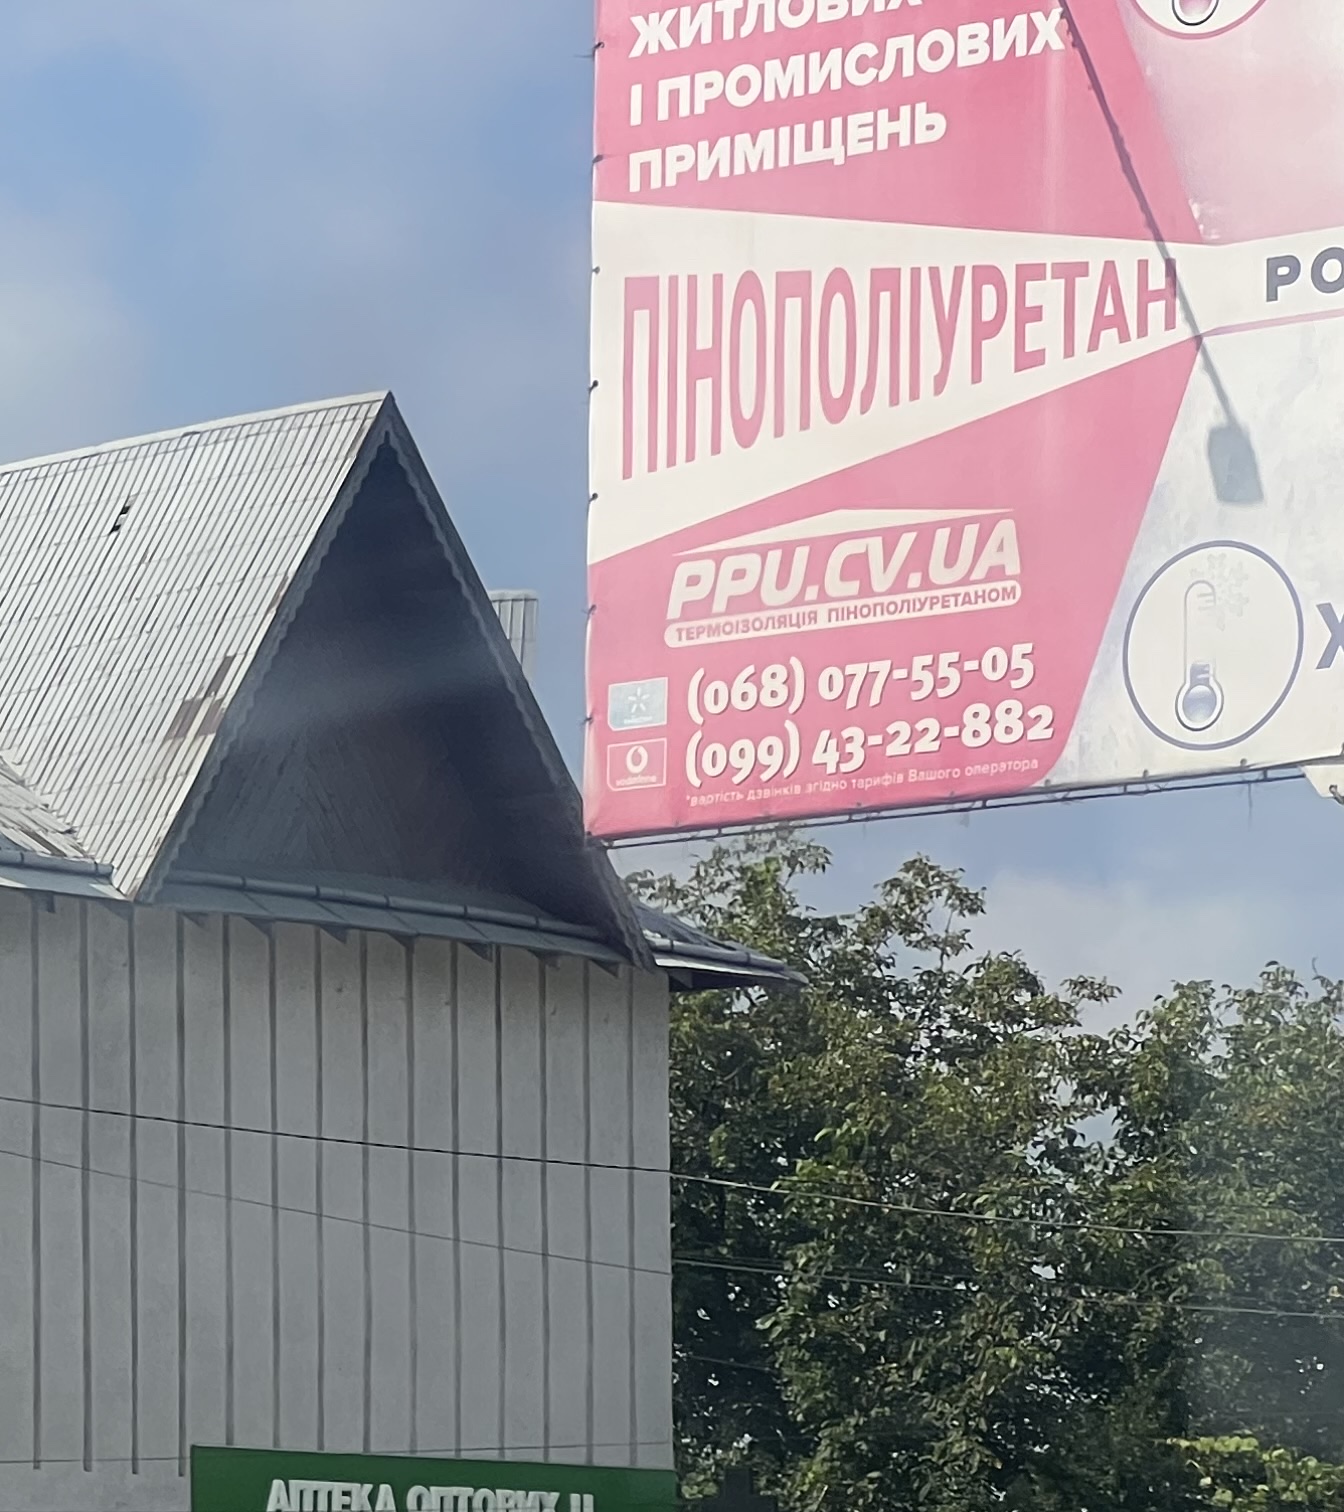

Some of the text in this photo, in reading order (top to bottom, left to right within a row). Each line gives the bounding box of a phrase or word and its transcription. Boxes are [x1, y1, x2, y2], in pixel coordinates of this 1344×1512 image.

[628, 0, 923, 58] ЖИТЛОВ
[630, 8, 1067, 126] І ПРОМИСЛОВИХ
[628, 102, 947, 192] ПРИМІЩЕНЬ
[623, 258, 1178, 480] ПІНОПОЛІУРЕТАН
[666, 519, 1021, 620] PPU.CV.UA
[676, 586, 1018, 642] ТЕРМОІЗОЛЯЦІЯ ПІНОПОЛІУРЕТАНОМ
[687, 643, 1035, 726] (068) 077-55-05
[685, 699, 1055, 788] (099) 43-22-882
[909, 767, 961, 784] Вашого
[965, 759, 1039, 778] оператора
